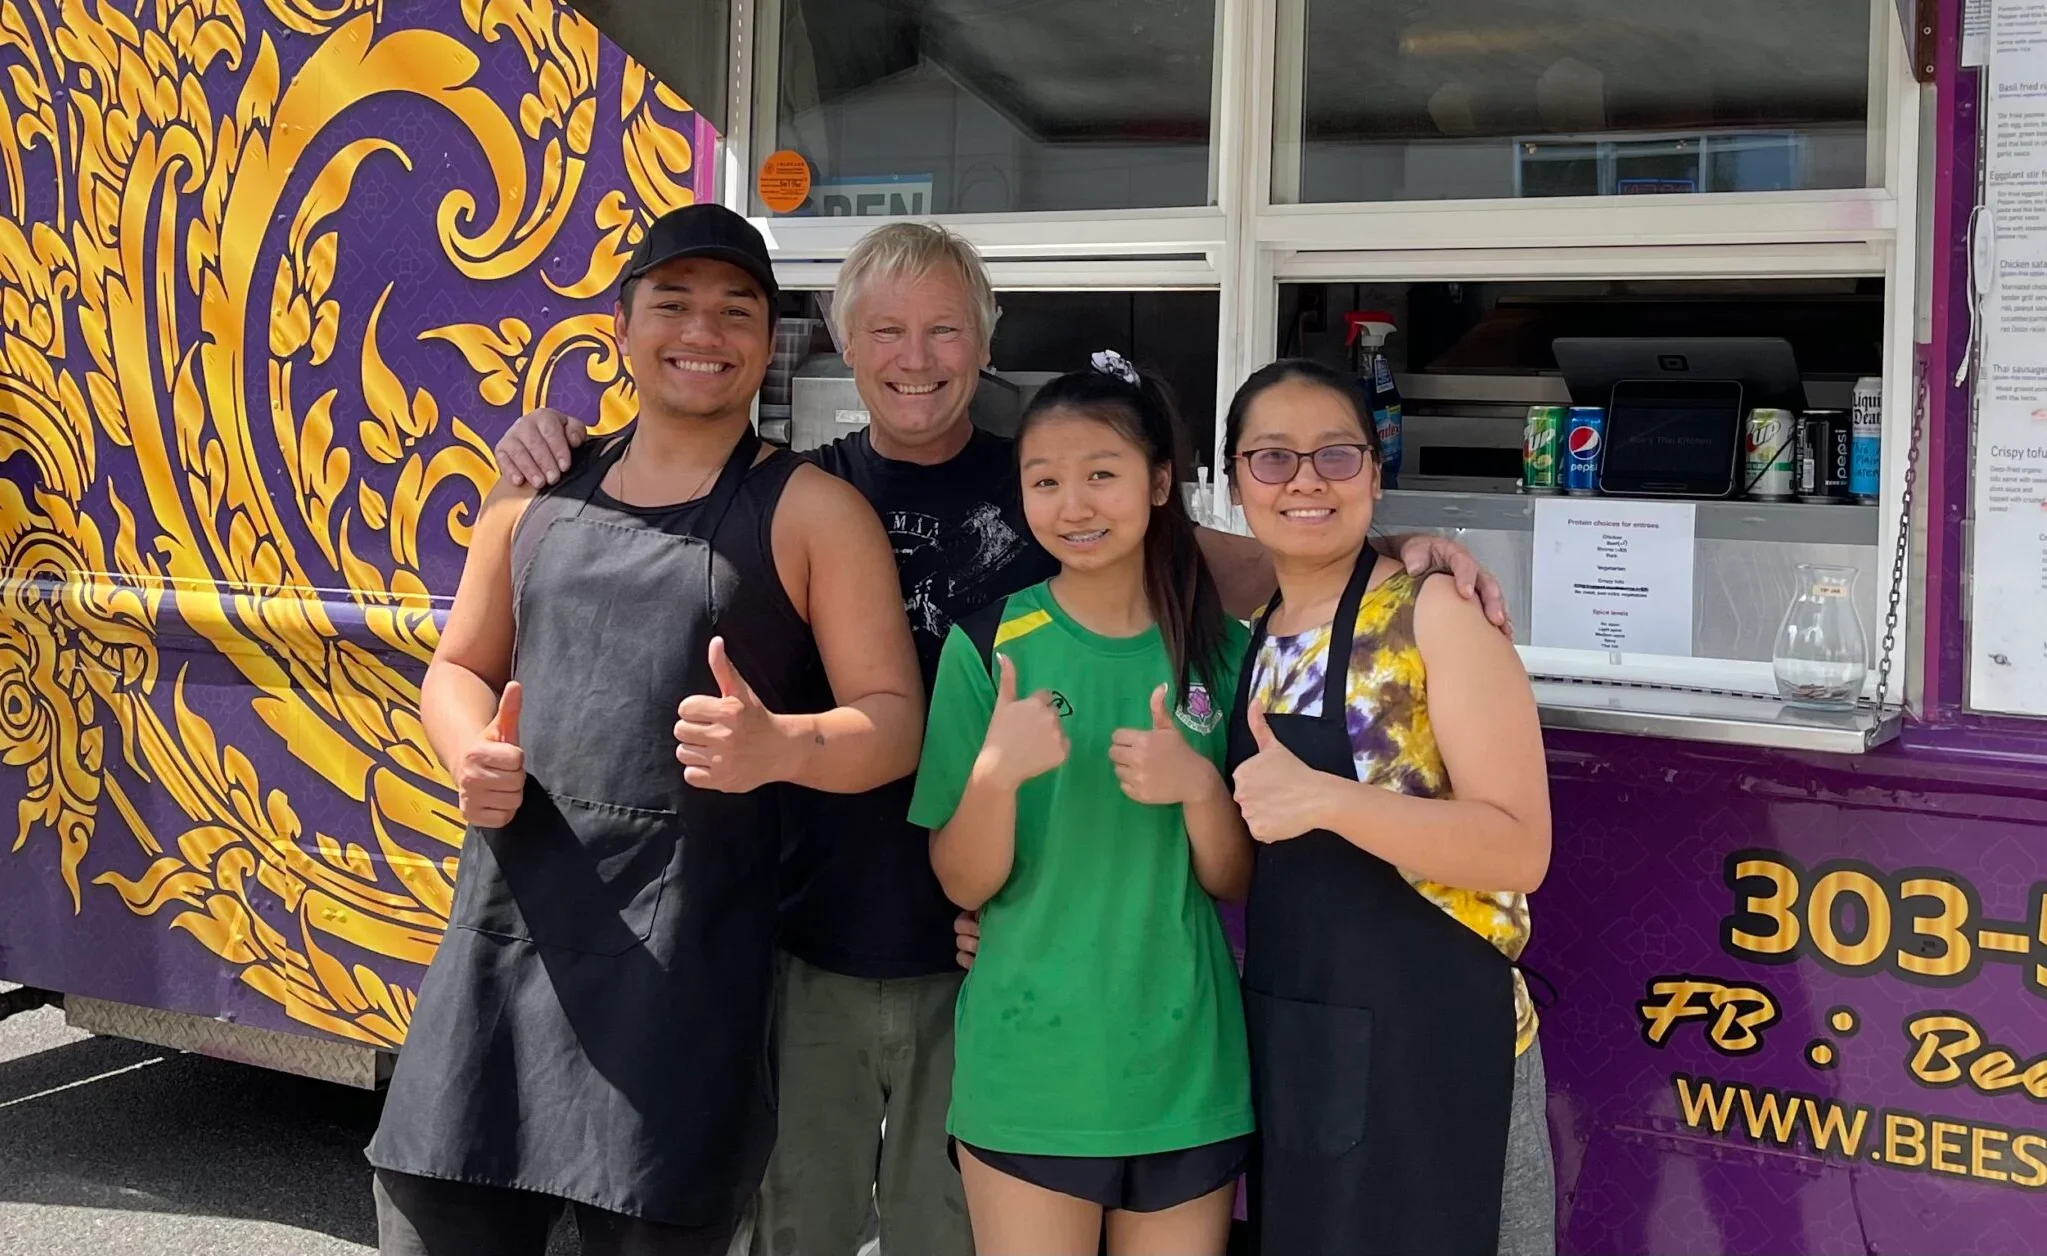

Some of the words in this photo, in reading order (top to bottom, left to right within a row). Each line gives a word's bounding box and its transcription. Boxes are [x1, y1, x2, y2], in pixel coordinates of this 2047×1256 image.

[1999, 82, 2018, 92] Basil
[2019, 81, 2038, 91] fried
[1989, 170, 2023, 181] Eggplant
[2027, 170, 2039, 178] stir
[2000, 259, 2029, 269] Chicken
[1992, 363, 2009, 373] Thai
[1835, 429, 1847, 479] pepsi
[1991, 445, 2024, 460] Crispy
[2026, 446, 2047, 458] tofu
[1570, 463, 1597, 473] pepsi
[1568, 518, 1592, 527] Protein
[1593, 519, 1620, 528] choices
[1621, 520, 1631, 528] for
[1633, 521, 1660, 529] entrees
[1641, 980, 1775, 1052] FB
[1675, 1077, 2047, 1188] WWW.BEES
